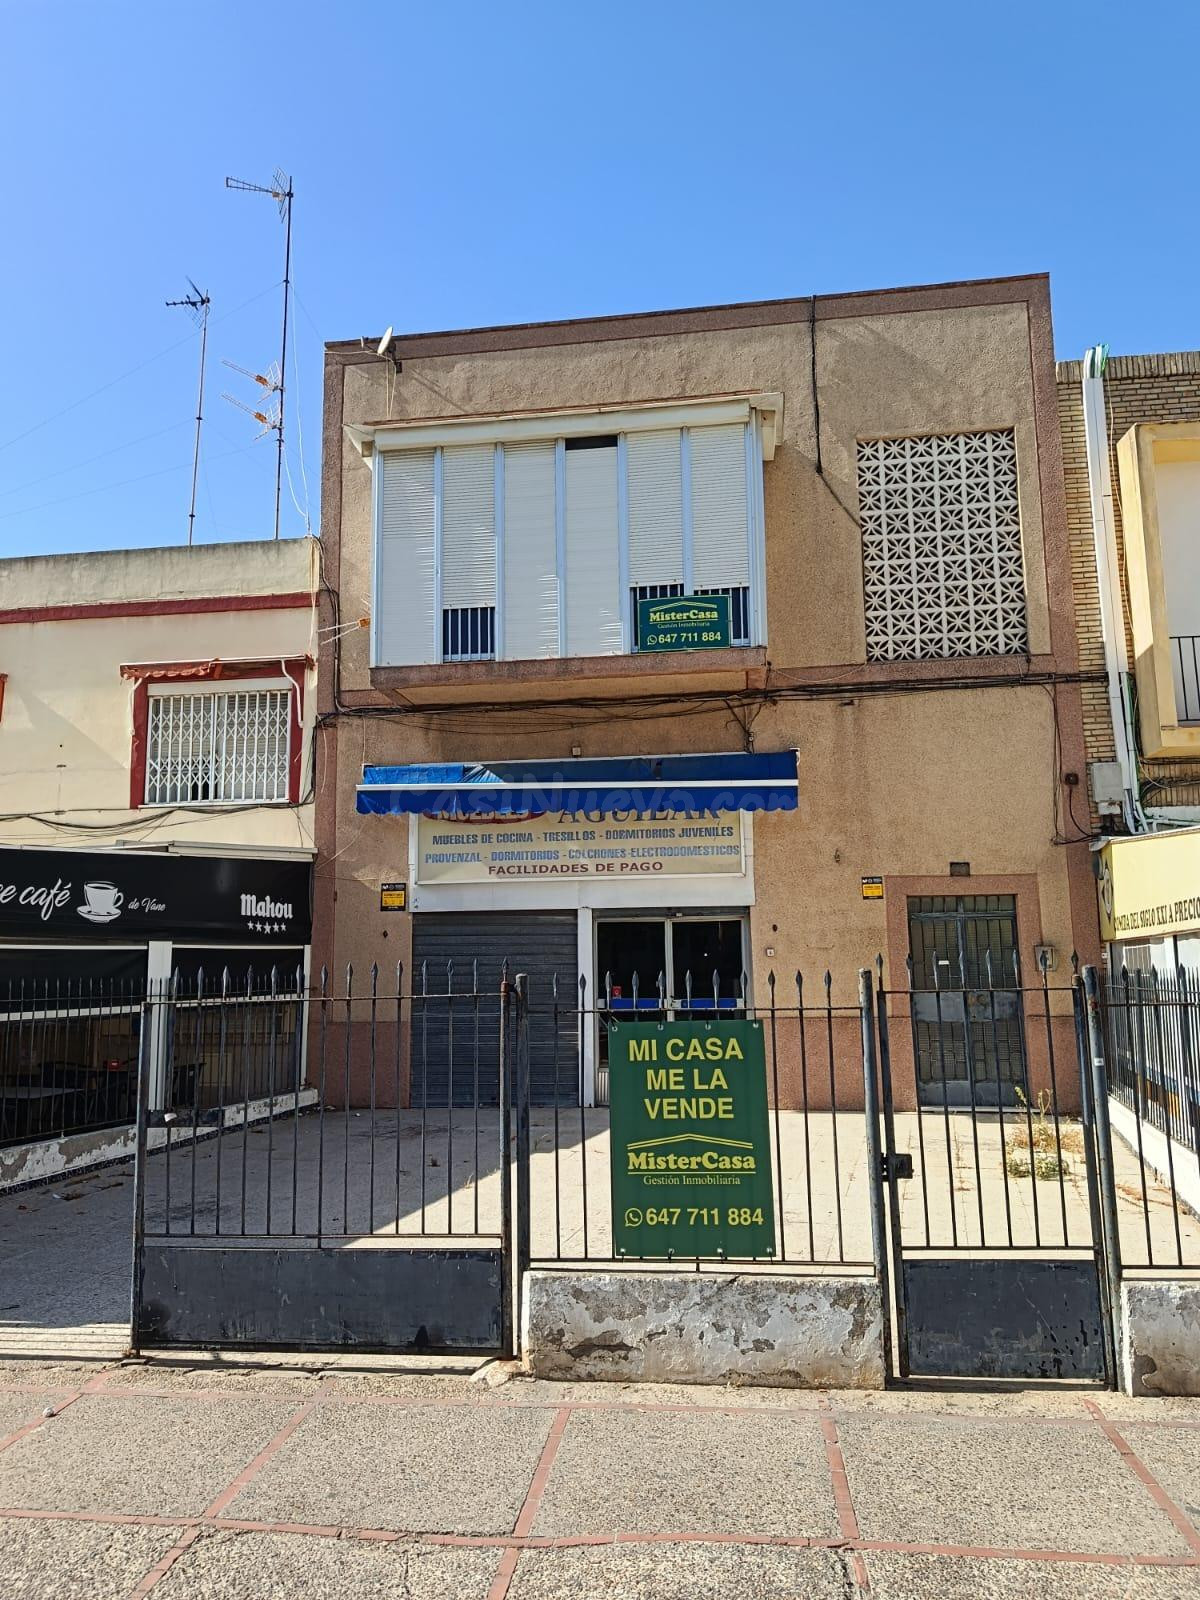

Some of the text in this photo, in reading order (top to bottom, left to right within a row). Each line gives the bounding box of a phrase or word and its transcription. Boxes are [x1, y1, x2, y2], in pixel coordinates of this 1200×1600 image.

[649, 609, 718, 621] MisterCasa
[658, 631, 722, 644] 647 711 884
[432, 834, 478, 845] MUEBLES
[481, 833, 493, 844] DE
[496, 832, 533, 844] COCINA
[543, 830, 596, 842] TRESILLOS
[605, 828, 676, 840] DORMITORIOS
[678, 826, 734, 838] JUVENILES
[425, 852, 482, 863] PROVENZAL
[491, 850, 559, 861] DORMITORIOS
[568, 847, 626, 860] COLCHONES
[488, 861, 663, 875] FACILIDADES DE PAGO
[19, 878, 72, 921] café
[128, 897, 166, 913] de Vane
[240, 893, 293, 919] Mahou
[1130, 912, 1140, 930] DEL
[1140, 908, 1155, 928] SIGLO
[1156, 904, 1168, 925] XXI
[628, 1037, 744, 1062] MI CASA
[646, 1068, 728, 1090] ME LA
[643, 1097, 735, 1120] VENDE
[627, 1151, 757, 1170] MisterCasa
[643, 1174, 741, 1185] Gestión Inmobiliaria
[646, 1207, 764, 1226] 647 711 884
